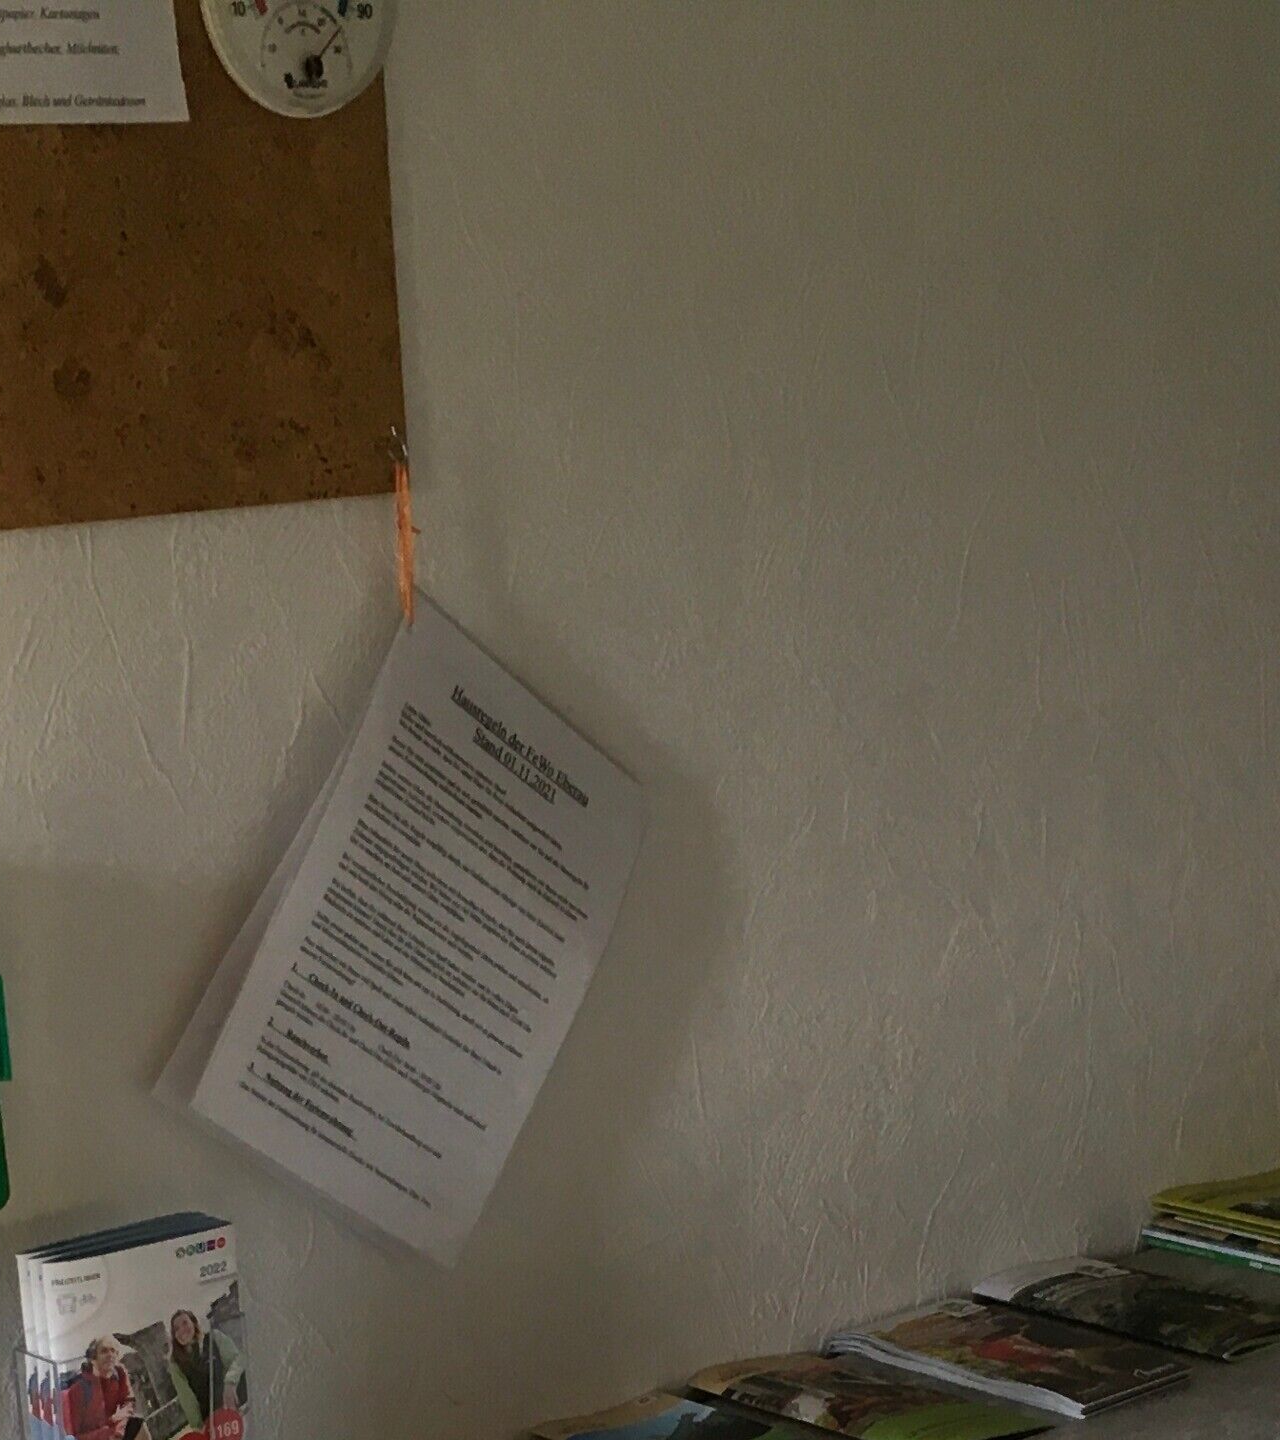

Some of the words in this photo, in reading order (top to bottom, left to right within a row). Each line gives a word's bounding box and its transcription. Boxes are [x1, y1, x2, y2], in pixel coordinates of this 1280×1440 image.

[231, 1, 246, 16] 10
[356, 2, 373, 19] 90
[200, 1261, 228, 1278] 2022
